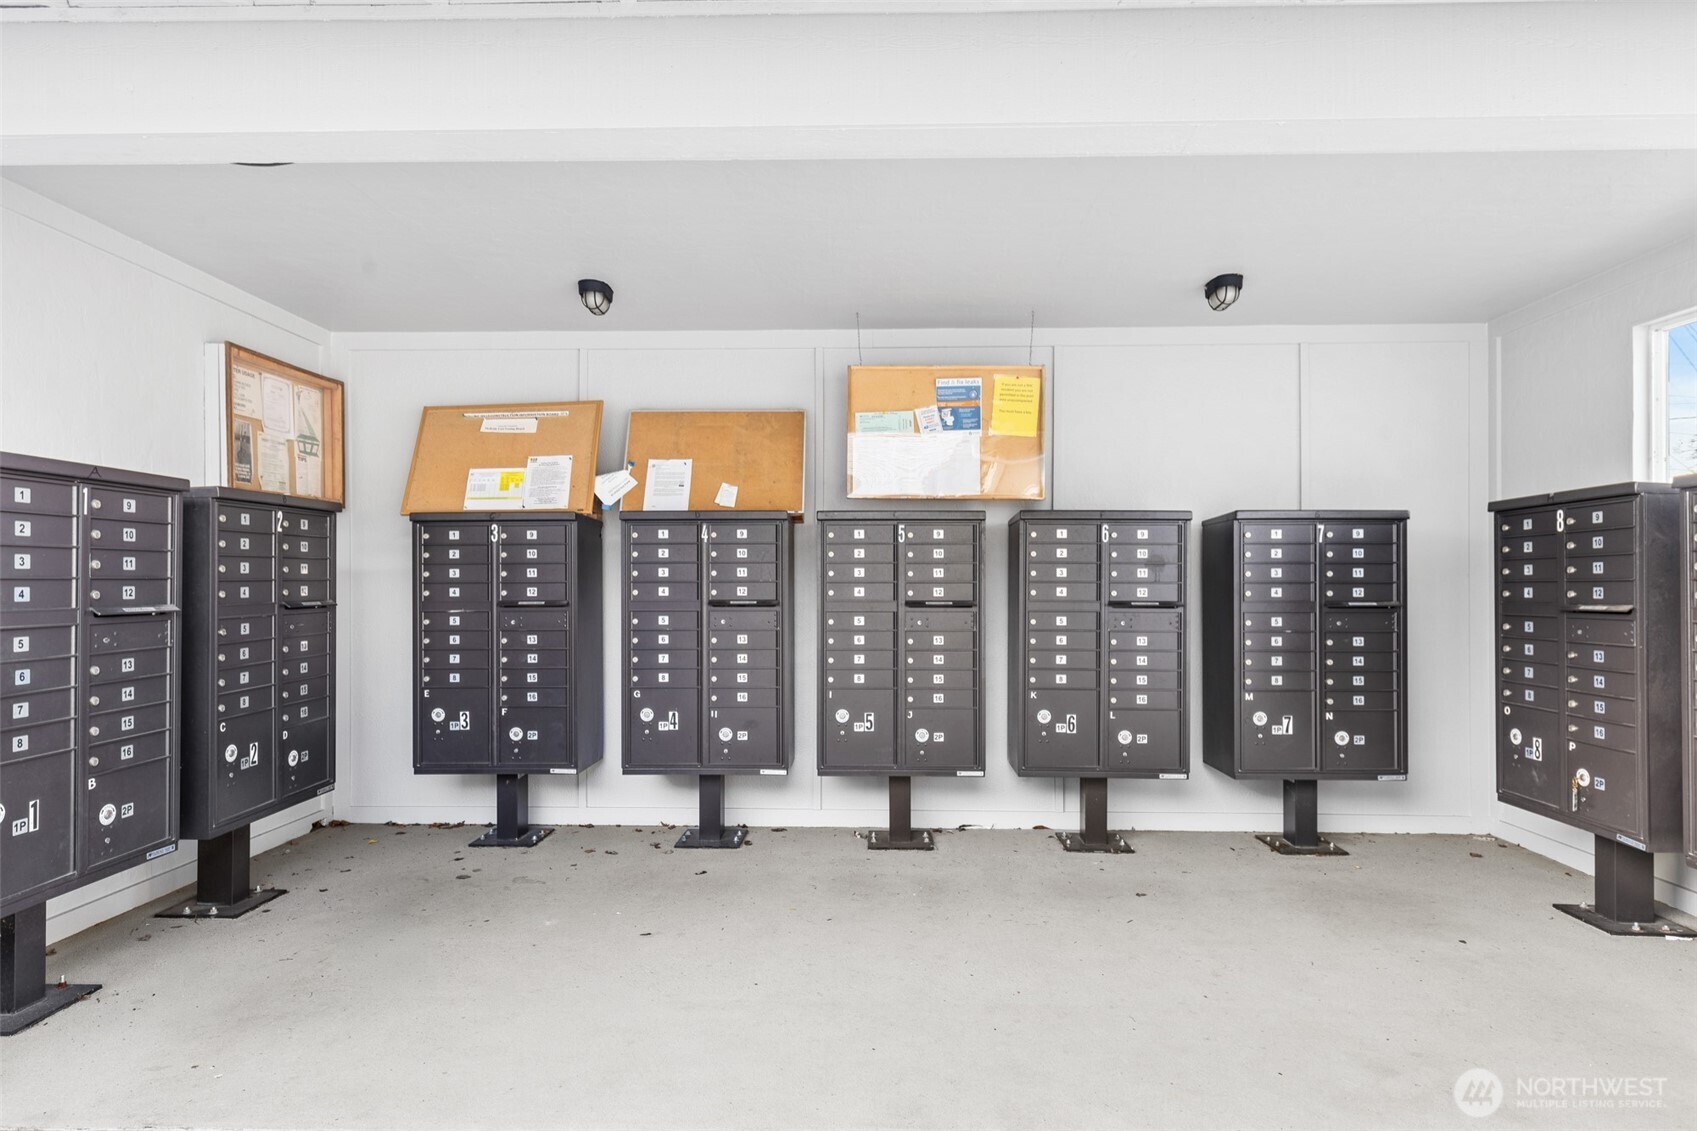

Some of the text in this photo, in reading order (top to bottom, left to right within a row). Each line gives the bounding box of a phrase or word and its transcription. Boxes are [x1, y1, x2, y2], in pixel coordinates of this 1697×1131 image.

[87, 466, 102, 478] A
[82, 487, 88, 515] 1
[126, 500, 132, 511] 9
[277, 510, 283, 533] 2
[1556, 509, 1564, 532] 8
[19, 523, 26, 534] 2
[491, 523, 498, 542] 3
[701, 524, 709, 543] 4
[898, 524, 905, 543] 5
[1102, 524, 1109, 543] 6
[1317, 524, 1325, 543] 7
[124, 530, 134, 540] 10
[18, 556, 26, 567] 3
[124, 559, 133, 568] 11
[18, 589, 25, 599] 4
[124, 588, 134, 598] 12
[17, 638, 24, 650] 5
[123, 659, 133, 670] 13
[19, 671, 26, 682] 6
[123, 689, 133, 699] 14
[424, 689, 430, 698] E
[633, 690, 641, 698] G
[1030, 691, 1037, 699] K
[1244, 692, 1254, 701] M
[17, 704, 24, 715] 7
[501, 707, 508, 716] F
[907, 710, 913, 719] J
[1110, 711, 1116, 719] L
[461, 712, 469, 730] 3
[669, 712, 678, 730] 4
[1325, 712, 1334, 720] N
[123, 717, 133, 728] 15
[219, 722, 226, 732] C
[865, 713, 873, 731] 5
[1067, 715, 1076, 733] 6
[1283, 716, 1292, 734] 7
[283, 730, 288, 740] D
[16, 738, 24, 749] 8
[1568, 741, 1577, 751] P
[122, 746, 132, 757] 16
[250, 743, 257, 765] 2
[1534, 739, 1541, 760] 8
[88, 778, 96, 790] B
[30, 800, 39, 831] 1
[122, 804, 133, 816] 2P
[13, 820, 27, 833] 1P
